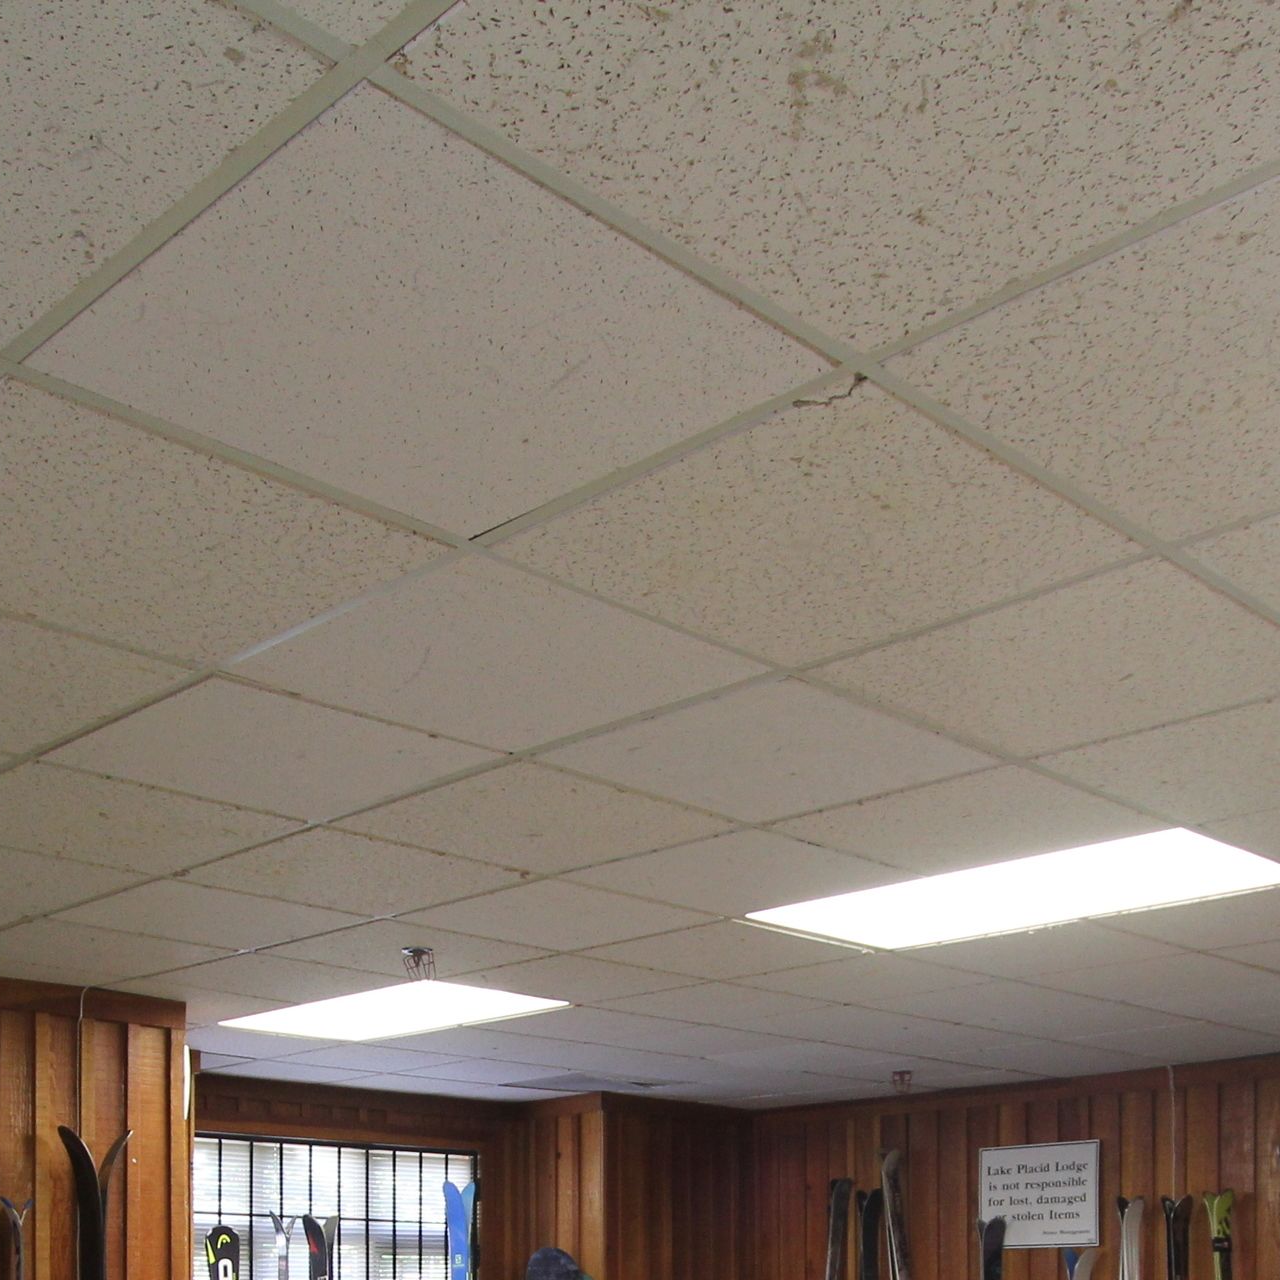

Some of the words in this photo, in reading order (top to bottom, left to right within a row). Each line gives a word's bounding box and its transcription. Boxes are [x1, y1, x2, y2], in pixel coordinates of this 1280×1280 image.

[987, 1165, 1013, 1176] Lake
[1016, 1163, 1050, 1174] Placid
[1055, 1161, 1089, 1173] Lodge
[988, 1182, 998, 1191] is
[1002, 1181, 1020, 1190] not
[1024, 1177, 1088, 1191] responsible
[988, 1197, 1005, 1207] for
[1036, 1193, 1087, 1206] damaged
[1011, 1211, 1045, 1221] stolen
[1049, 1209, 1081, 1220] Items
